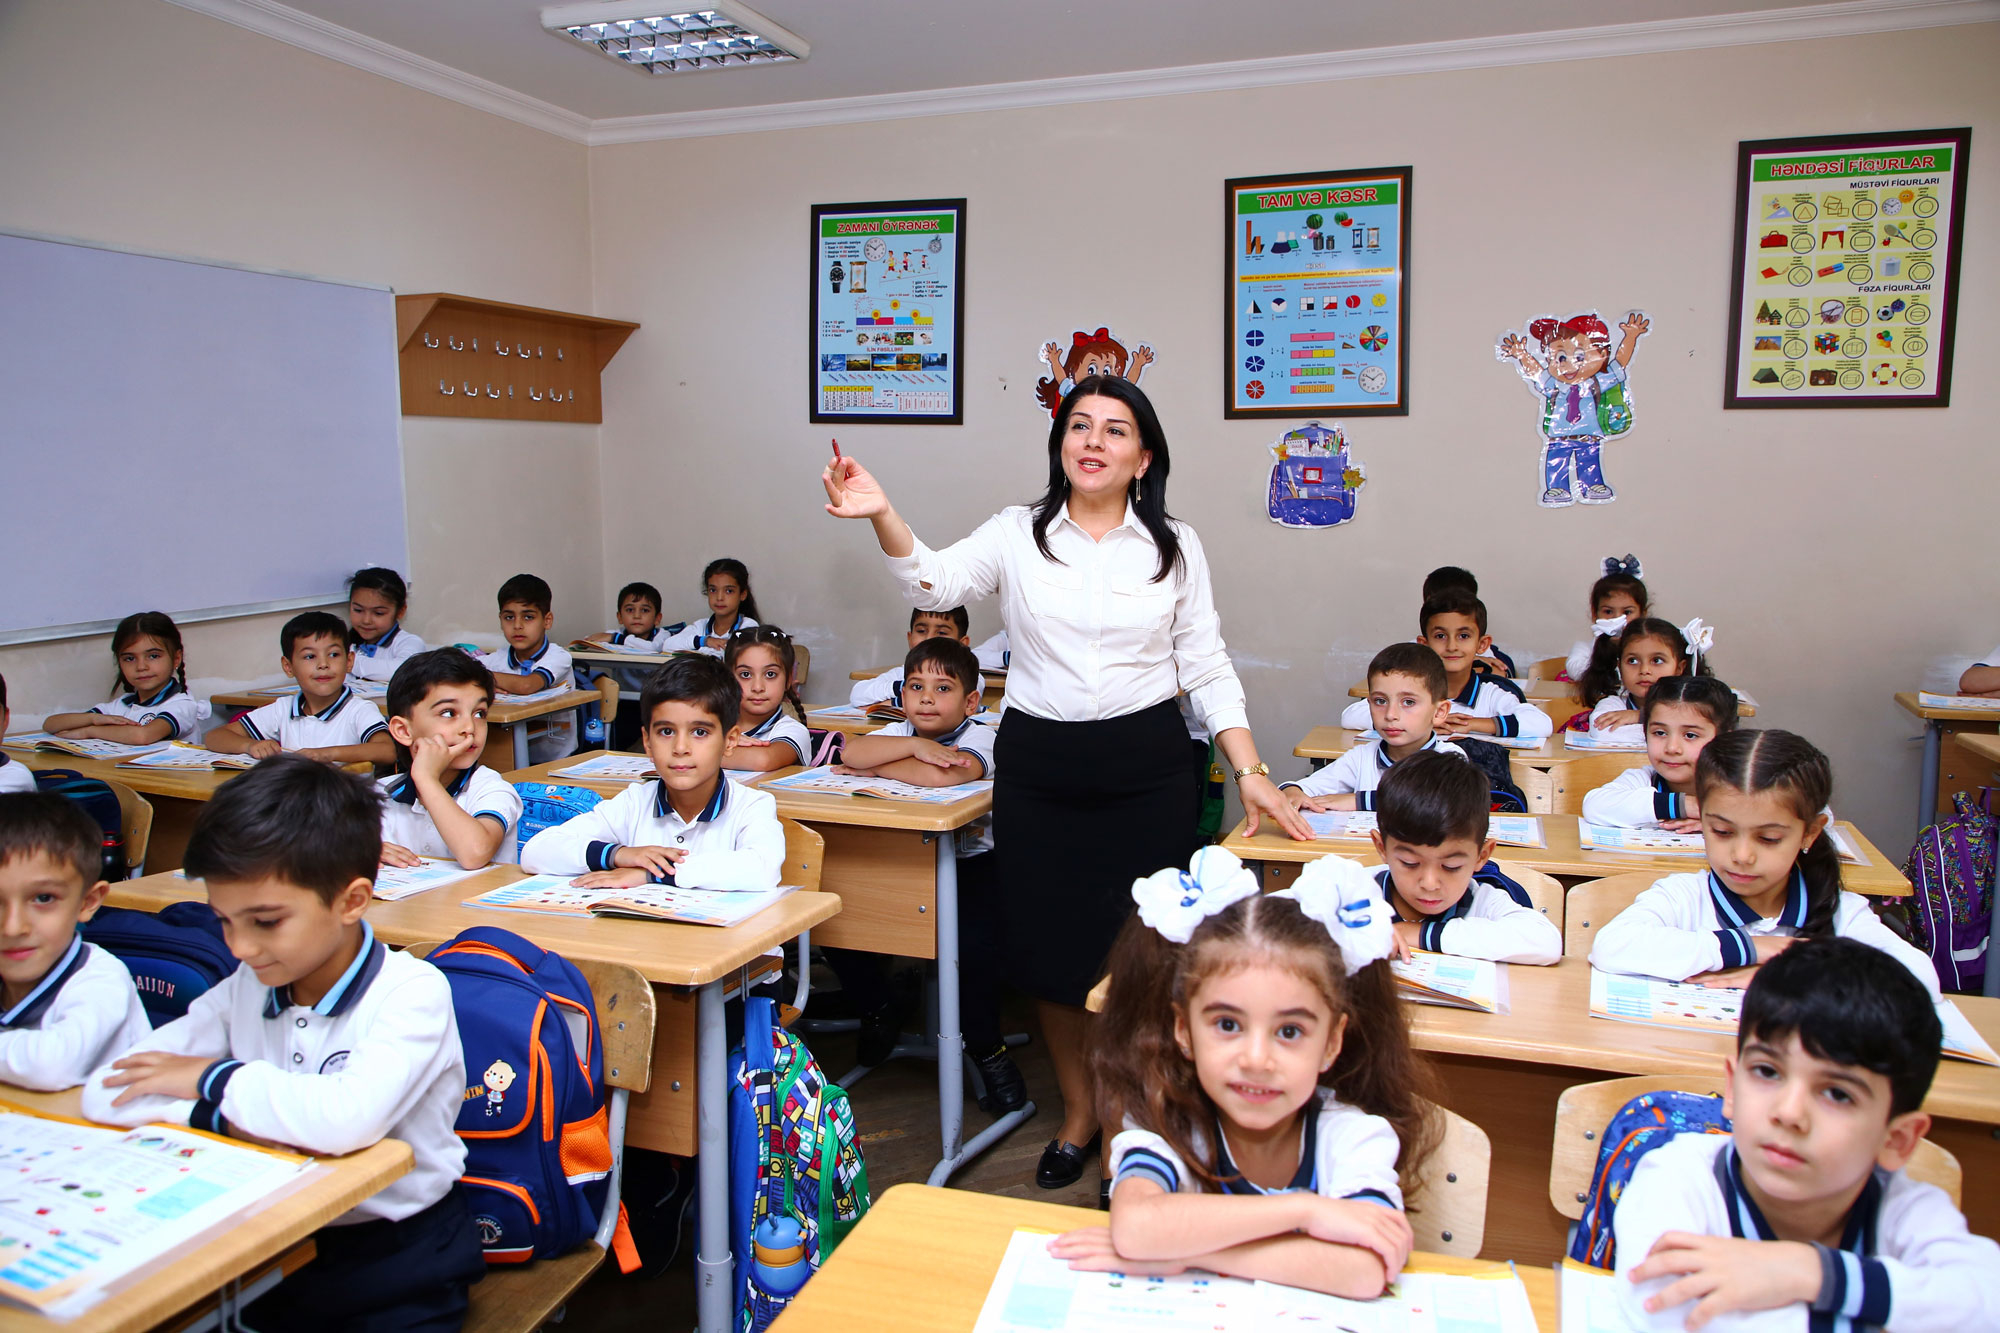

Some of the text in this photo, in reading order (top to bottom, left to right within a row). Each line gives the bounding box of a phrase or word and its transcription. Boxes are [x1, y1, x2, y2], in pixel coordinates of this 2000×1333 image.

[1770, 155, 1935, 177] HƏNDƏSİ FİQURLAR
[1850, 177, 1940, 189] MÜSTƏVİ FİQURLARI
[1257, 188, 1378, 209] TAM VƏ KƏSR
[837, 219, 939, 233] ZAMANI ÖYRƏNƏK
[1858, 283, 1931, 293] FƏZA FİQURLARI
[133, 975, 175, 998] AIJUN
